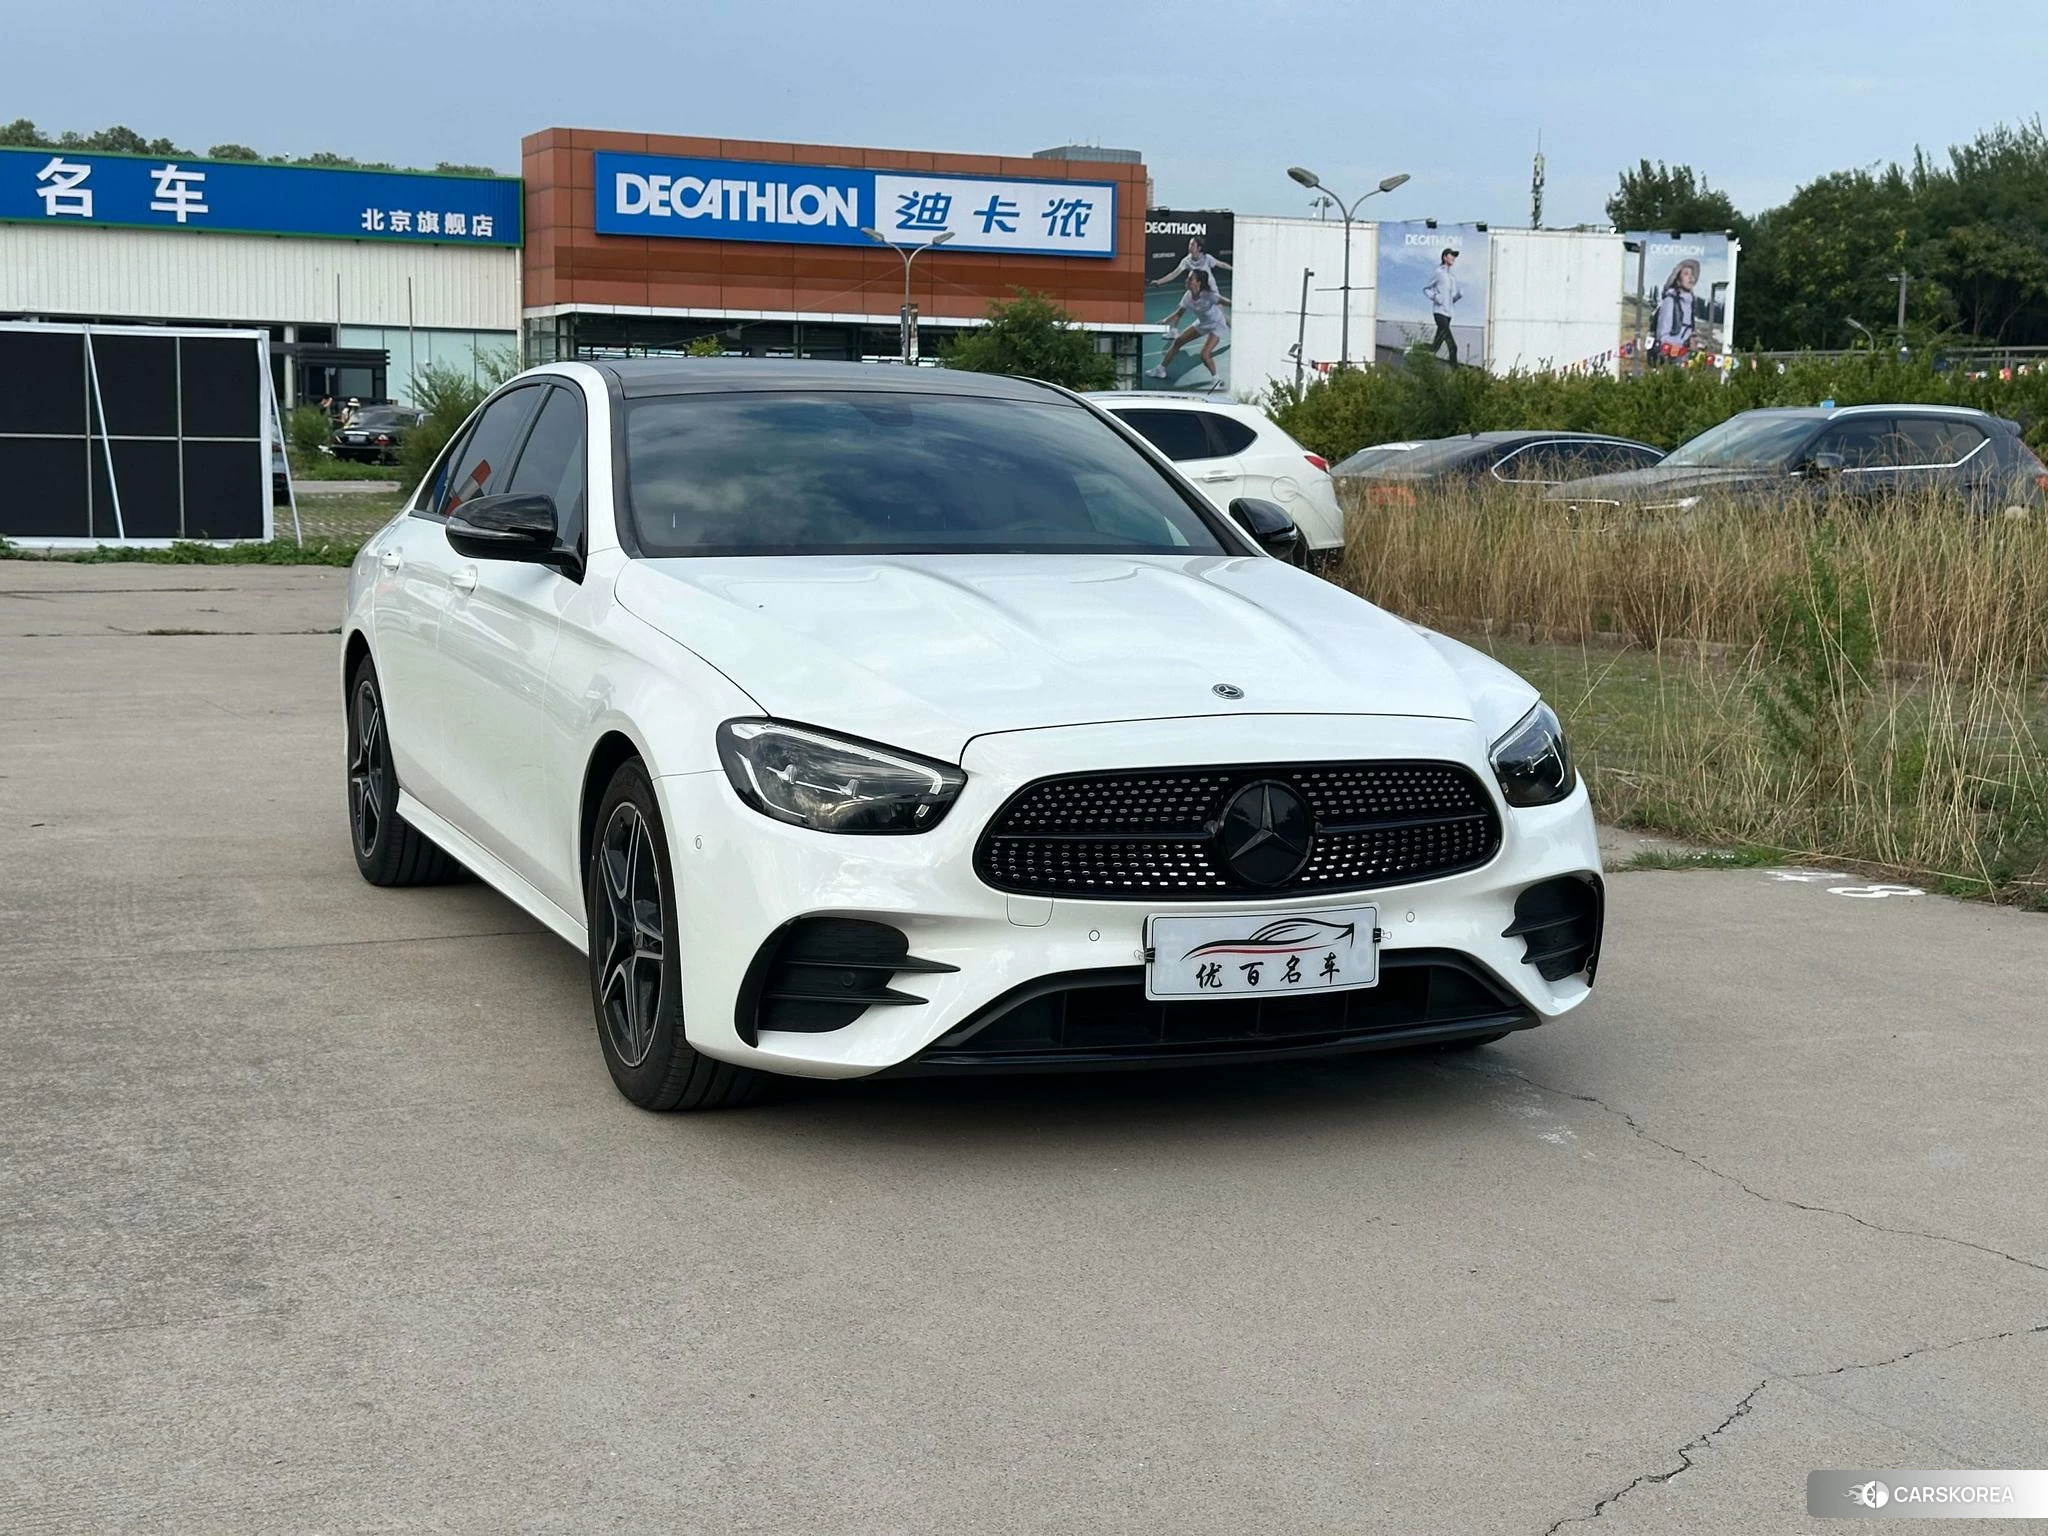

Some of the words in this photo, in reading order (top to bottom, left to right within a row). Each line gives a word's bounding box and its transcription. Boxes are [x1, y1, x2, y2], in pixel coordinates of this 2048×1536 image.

[36, 157, 209, 223] 名车
[616, 172, 858, 227] DECATHLON
[361, 208, 493, 237] 北京旗舰店
[895, 190, 1093, 237] 迪卡侬
[1144, 221, 1207, 236] DECATHLON
[1195, 952, 1341, 989] 优百名车
